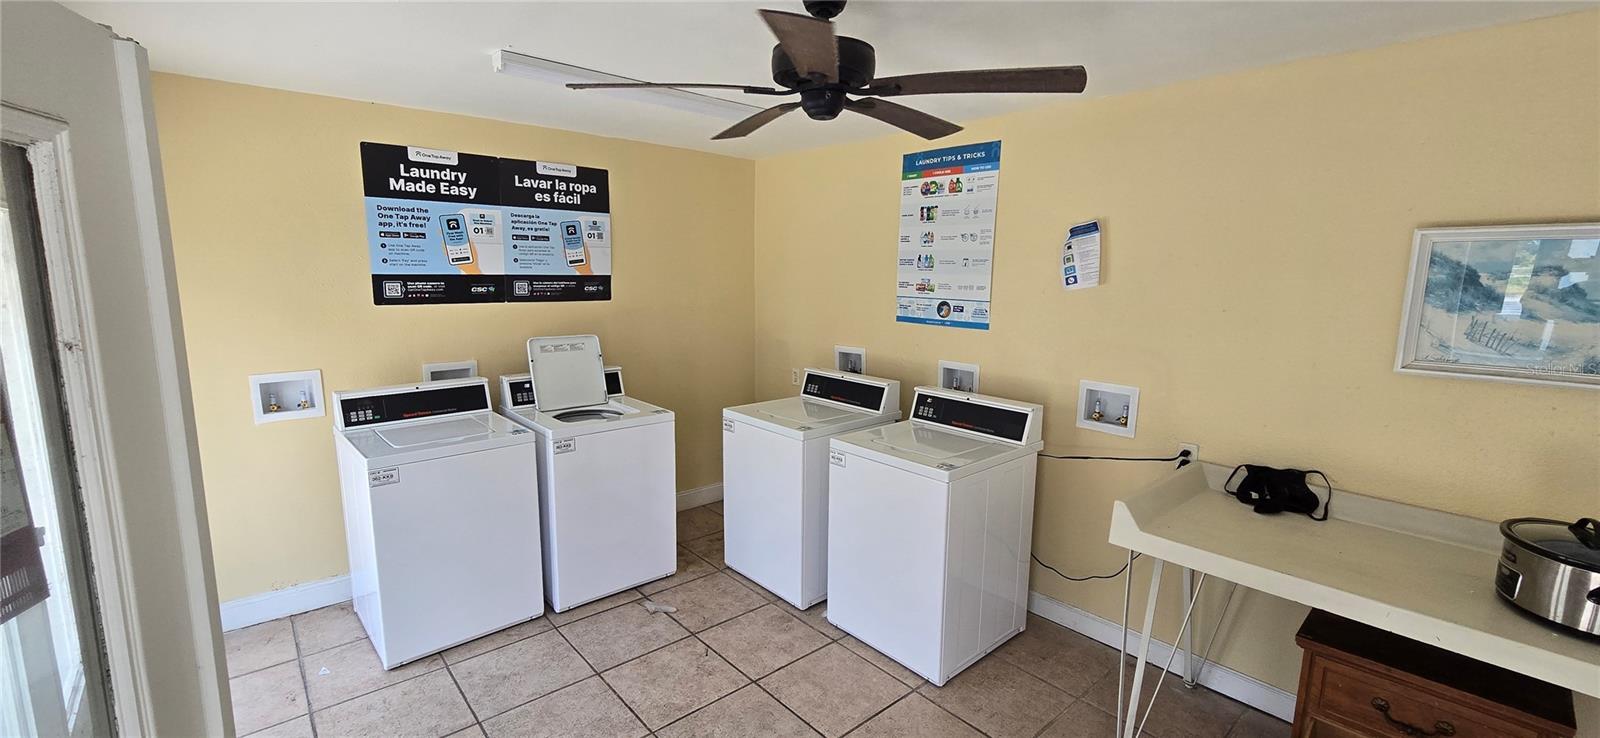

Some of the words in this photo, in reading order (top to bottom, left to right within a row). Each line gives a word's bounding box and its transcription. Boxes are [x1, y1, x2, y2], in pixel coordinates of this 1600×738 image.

[916, 157, 941, 166] LAUNDRY
[400, 164, 467, 184] Laundry
[389, 177, 436, 193] Made
[440, 182, 477, 199] Easy
[514, 175, 552, 189] Lavar
[555, 179, 566, 191] la
[569, 183, 597, 195] ropa
[535, 192, 550, 202] es
[553, 192, 580, 204] fácil
[377, 204, 415, 212] Download
